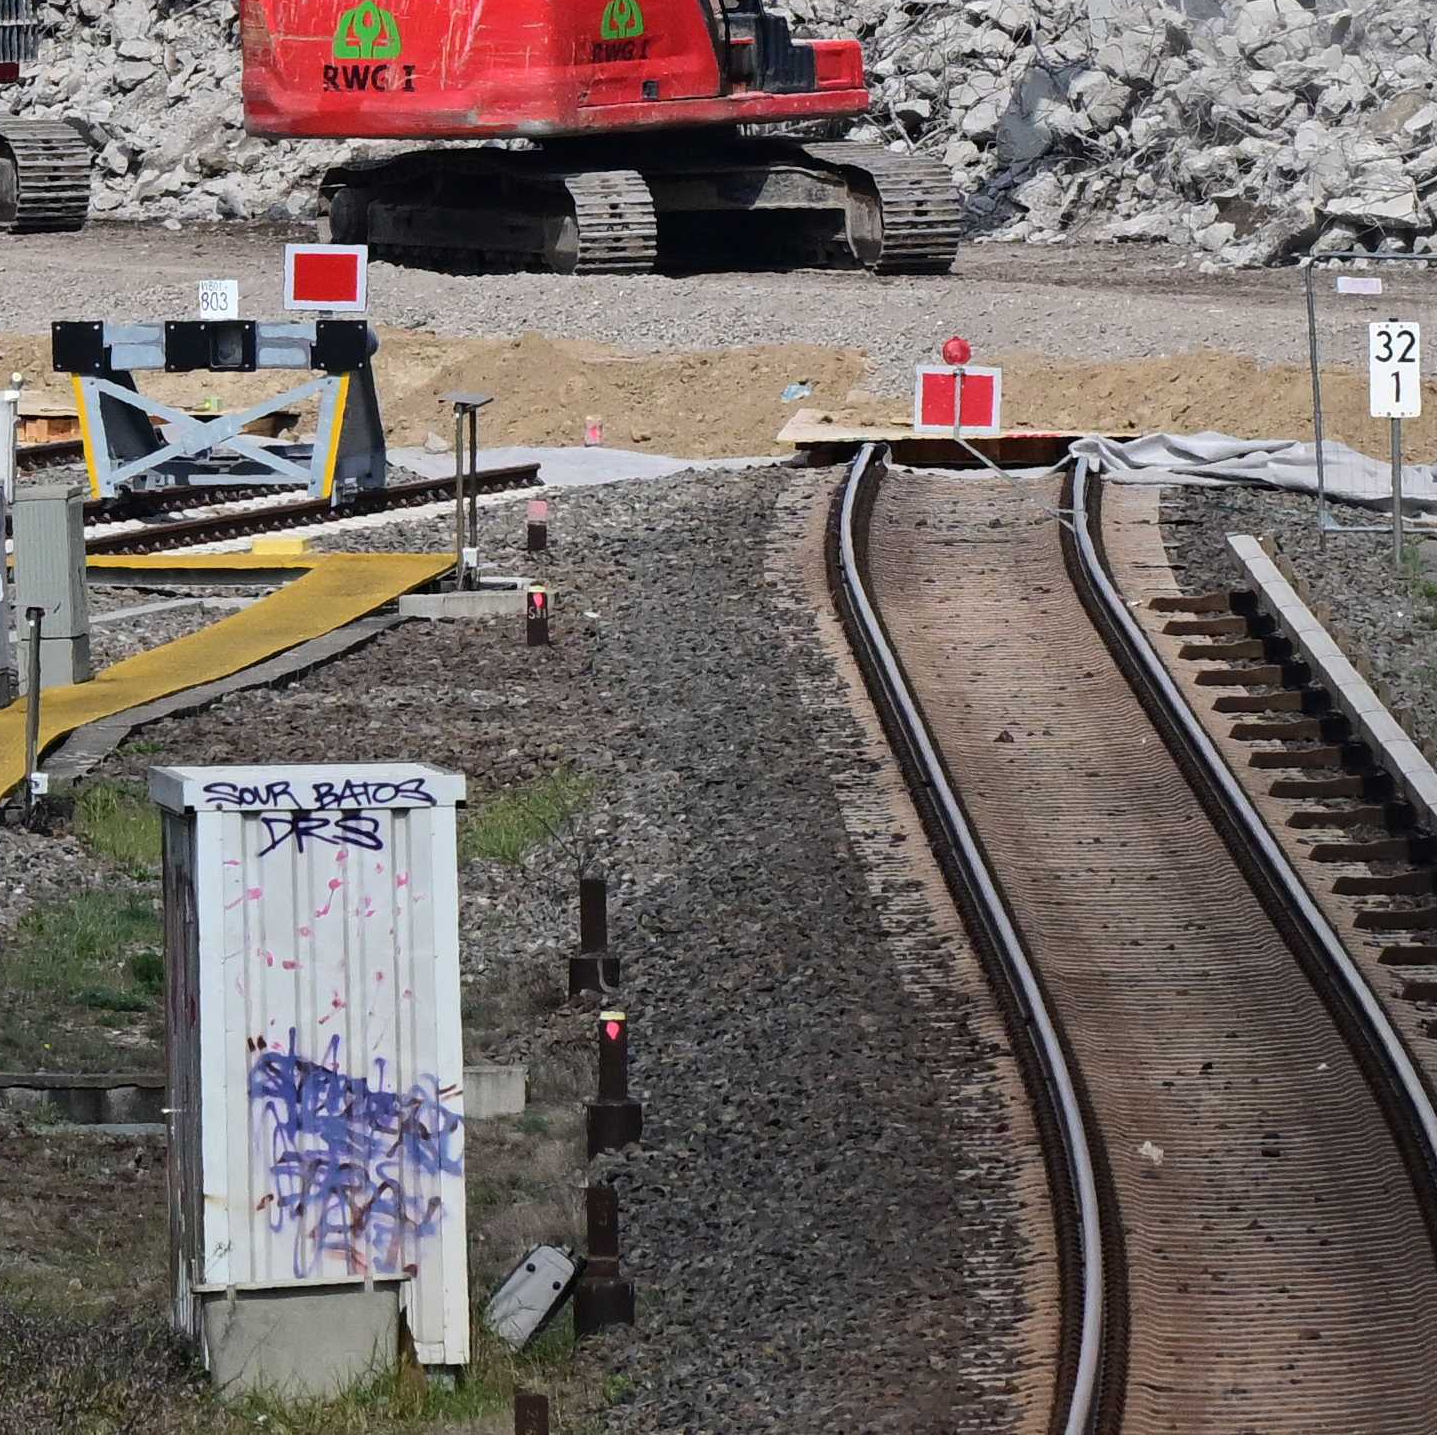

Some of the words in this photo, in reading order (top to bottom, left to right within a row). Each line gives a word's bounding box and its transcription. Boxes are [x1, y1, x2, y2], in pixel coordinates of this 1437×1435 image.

[593, 40, 635, 63] RWG
[323, 64, 393, 92] RWG
[201, 291, 228, 311] 803
[1375, 330, 1415, 363] 32
[1391, 371, 1401, 403] 1
